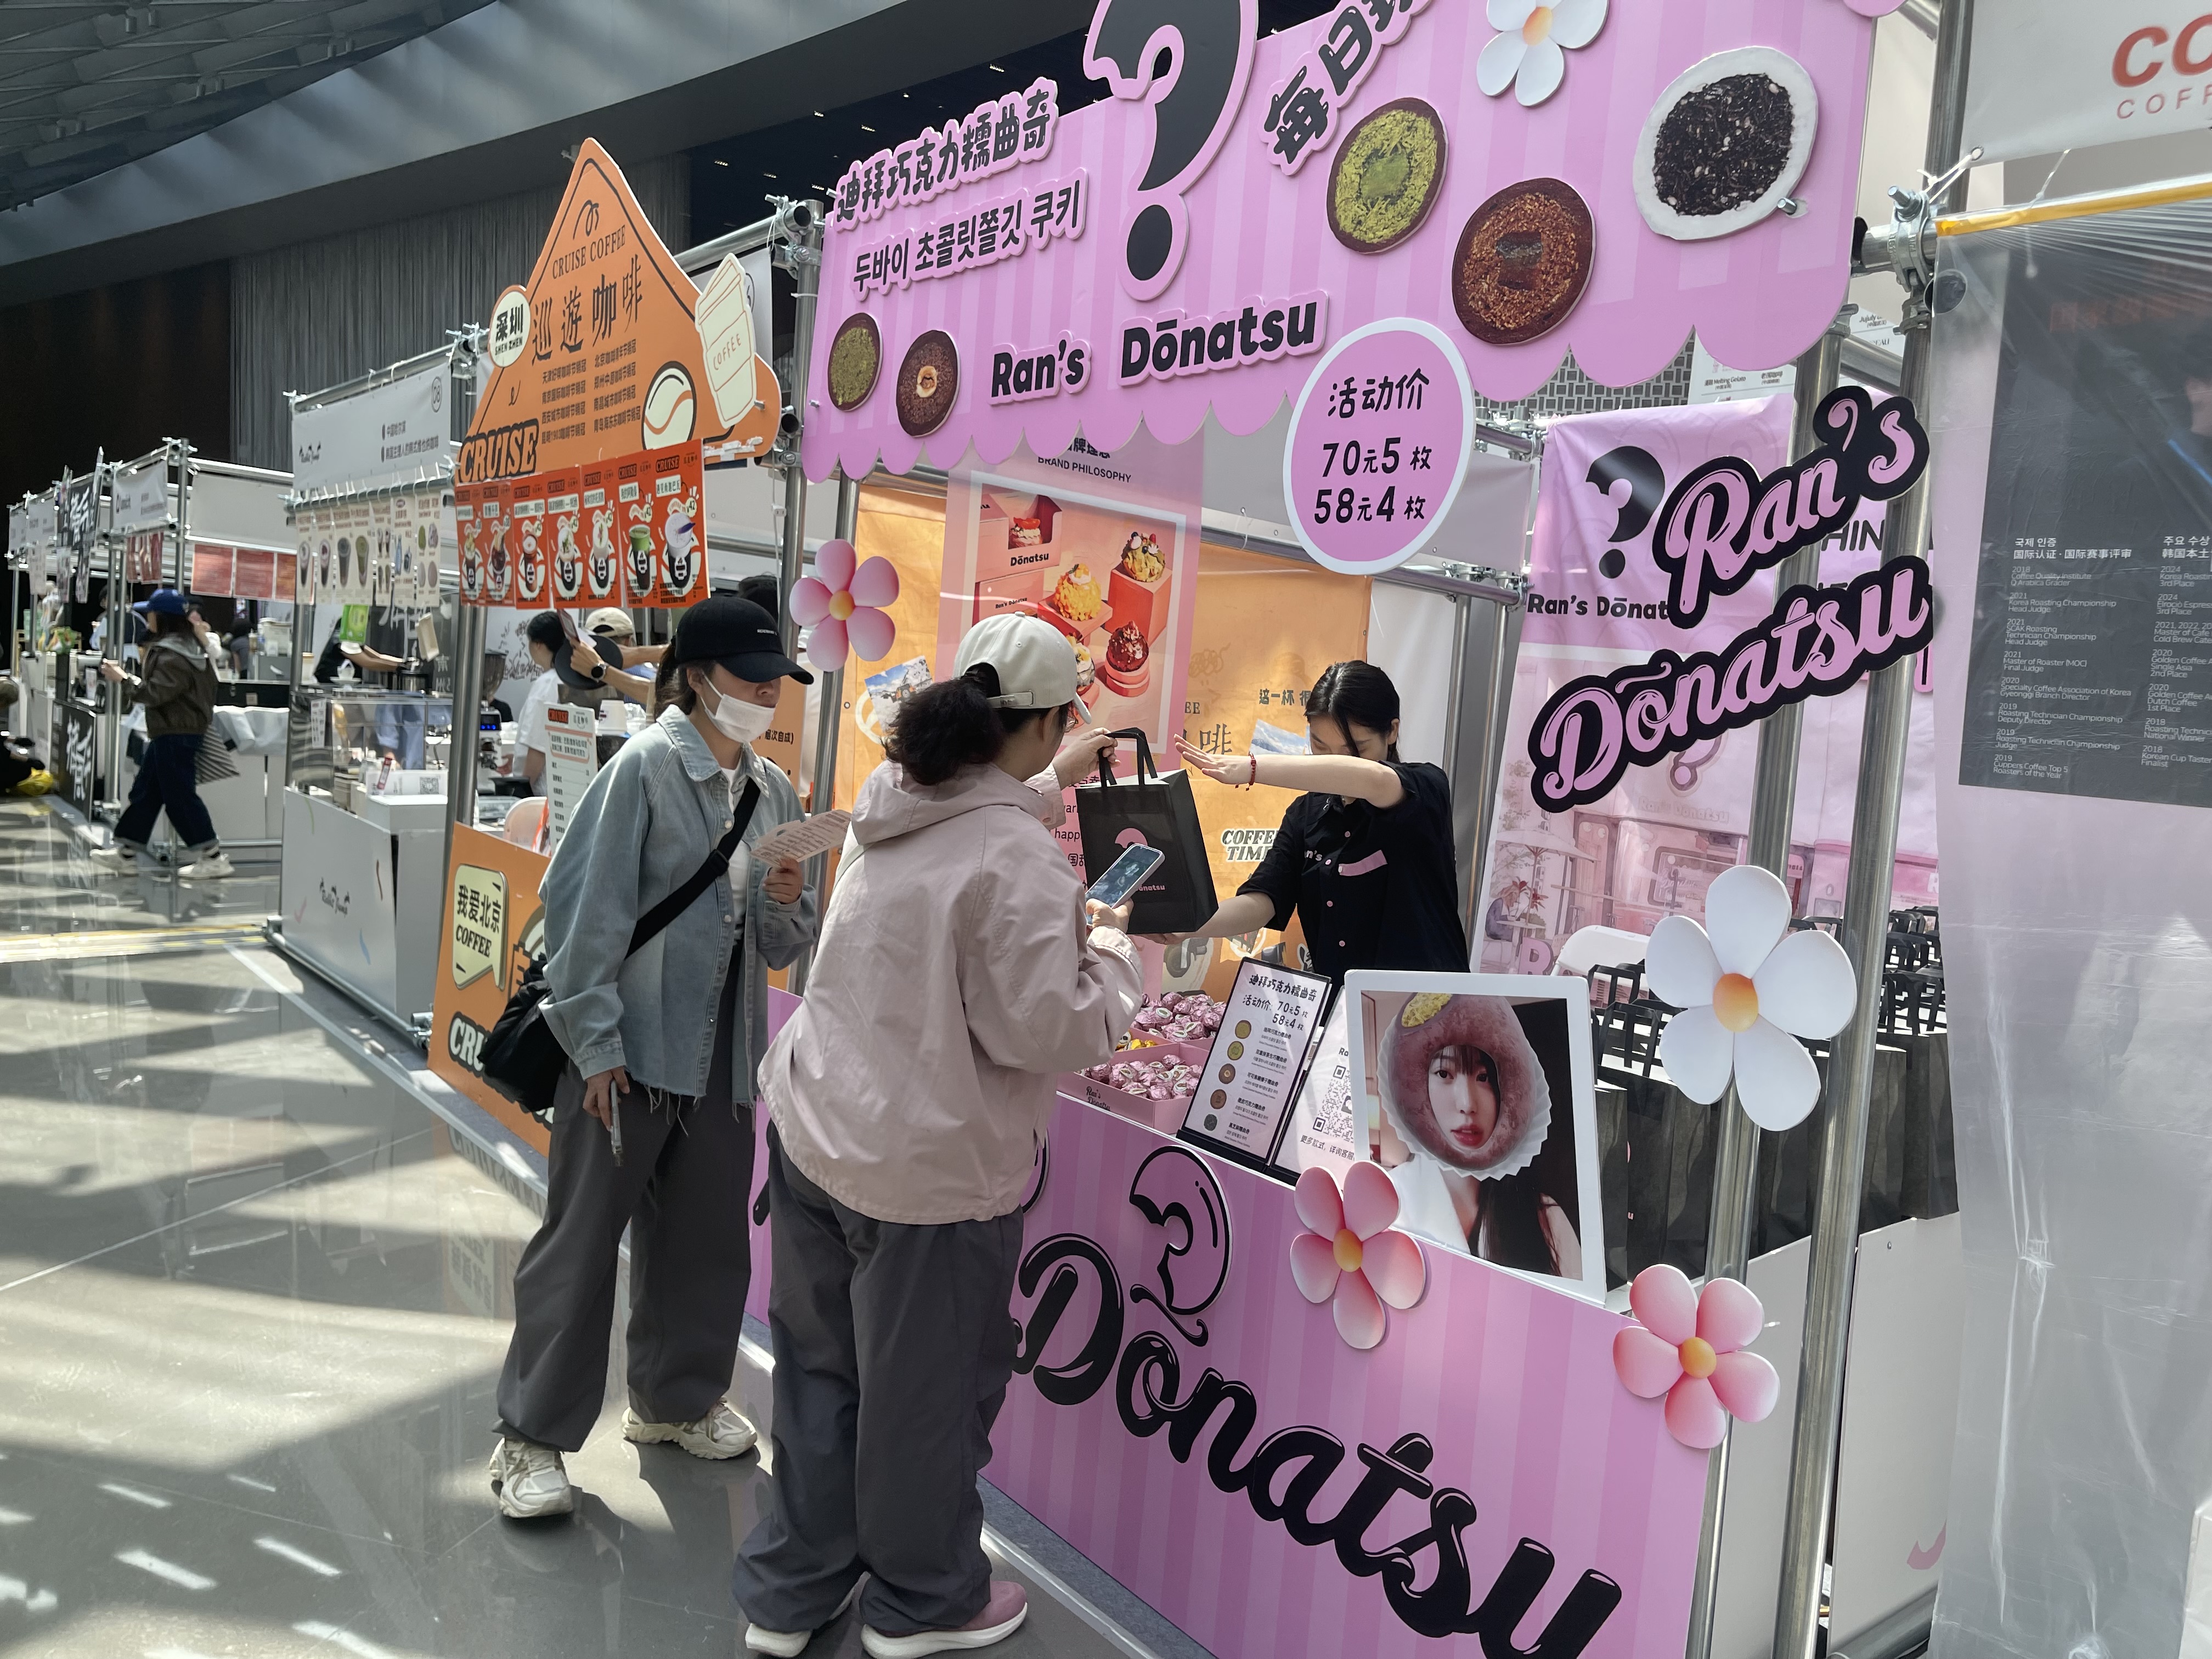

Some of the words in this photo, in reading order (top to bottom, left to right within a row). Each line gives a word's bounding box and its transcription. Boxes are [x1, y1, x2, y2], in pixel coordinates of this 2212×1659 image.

[837, 88, 1050, 222] 迪拜巧克力糯曲奇
[854, 238, 910, 294] 두바이
[915, 196, 1024, 272] 초콜릿쫄깃
[1029, 180, 1080, 238] 쿠키
[552, 246, 586, 280] CRUISE
[590, 224, 625, 262] COFFEE
[495, 303, 523, 342] 深圳
[495, 342, 508, 356] SHEN
[509, 336, 523, 351] ZHEN
[713, 334, 741, 370] COFFEE
[991, 328, 1085, 398] Ran's
[1121, 301, 1317, 379] Dōnatsu
[1328, 368, 1430, 419] 活动价
[460, 425, 538, 483] CRUISE
[619, 464, 637, 479] CRUISE
[656, 456, 680, 472] CRUISE
[1038, 457, 1070, 469] BRAND
[1072, 462, 1132, 483] PHILOSOPHY
[1665, 398, 1915, 614] Ran's
[2015, 538, 2034, 548] 국제
[2038, 538, 2056, 548] 인증
[2163, 536, 2185, 546] 주요
[2188, 535, 2210, 546] 수상
[1011, 553, 1049, 567] Dōnatsu
[2162, 549, 2212, 558] 韩国本土
[1527, 593, 1588, 616] Ran's
[2062, 599, 2117, 608] Championship
[2044, 632, 2097, 641] Championship
[2021, 665, 2044, 673] Judge
[1541, 568, 1929, 800] Dōnatsu
[2001, 684, 2032, 692] Specialty
[2148, 690, 2176, 698] Golden
[2160, 704, 2181, 713] Place
[2171, 698, 2198, 707] Coffee
[548, 709, 569, 724] CRUISE
[1997, 715, 2024, 724] Deputy
[1999, 709, 2029, 718] Roasting
[2030, 711, 2067, 719] Technician
[2069, 713, 2123, 724] Championship
[2143, 731, 2177, 740] National
[2145, 725, 2179, 733] Roasting
[1996, 735, 2027, 744] Roasting
[2028, 737, 2065, 746] Technician
[2067, 740, 2120, 751] Championship
[2142, 745, 2163, 753] 2018
[2141, 752, 2169, 760] Korean
[2170, 754, 2187, 763] Cup
[2141, 759, 2169, 768] Finalist
[1994, 761, 2023, 769] Cuppers
[2024, 763, 2047, 771] Coffee
[2049, 764, 2062, 772] Top
[1222, 830, 1279, 845] COFFE
[458, 884, 501, 934] 我爱北京
[456, 924, 492, 958] COFFEE
[1086, 1086, 1101, 1098] Ran's
